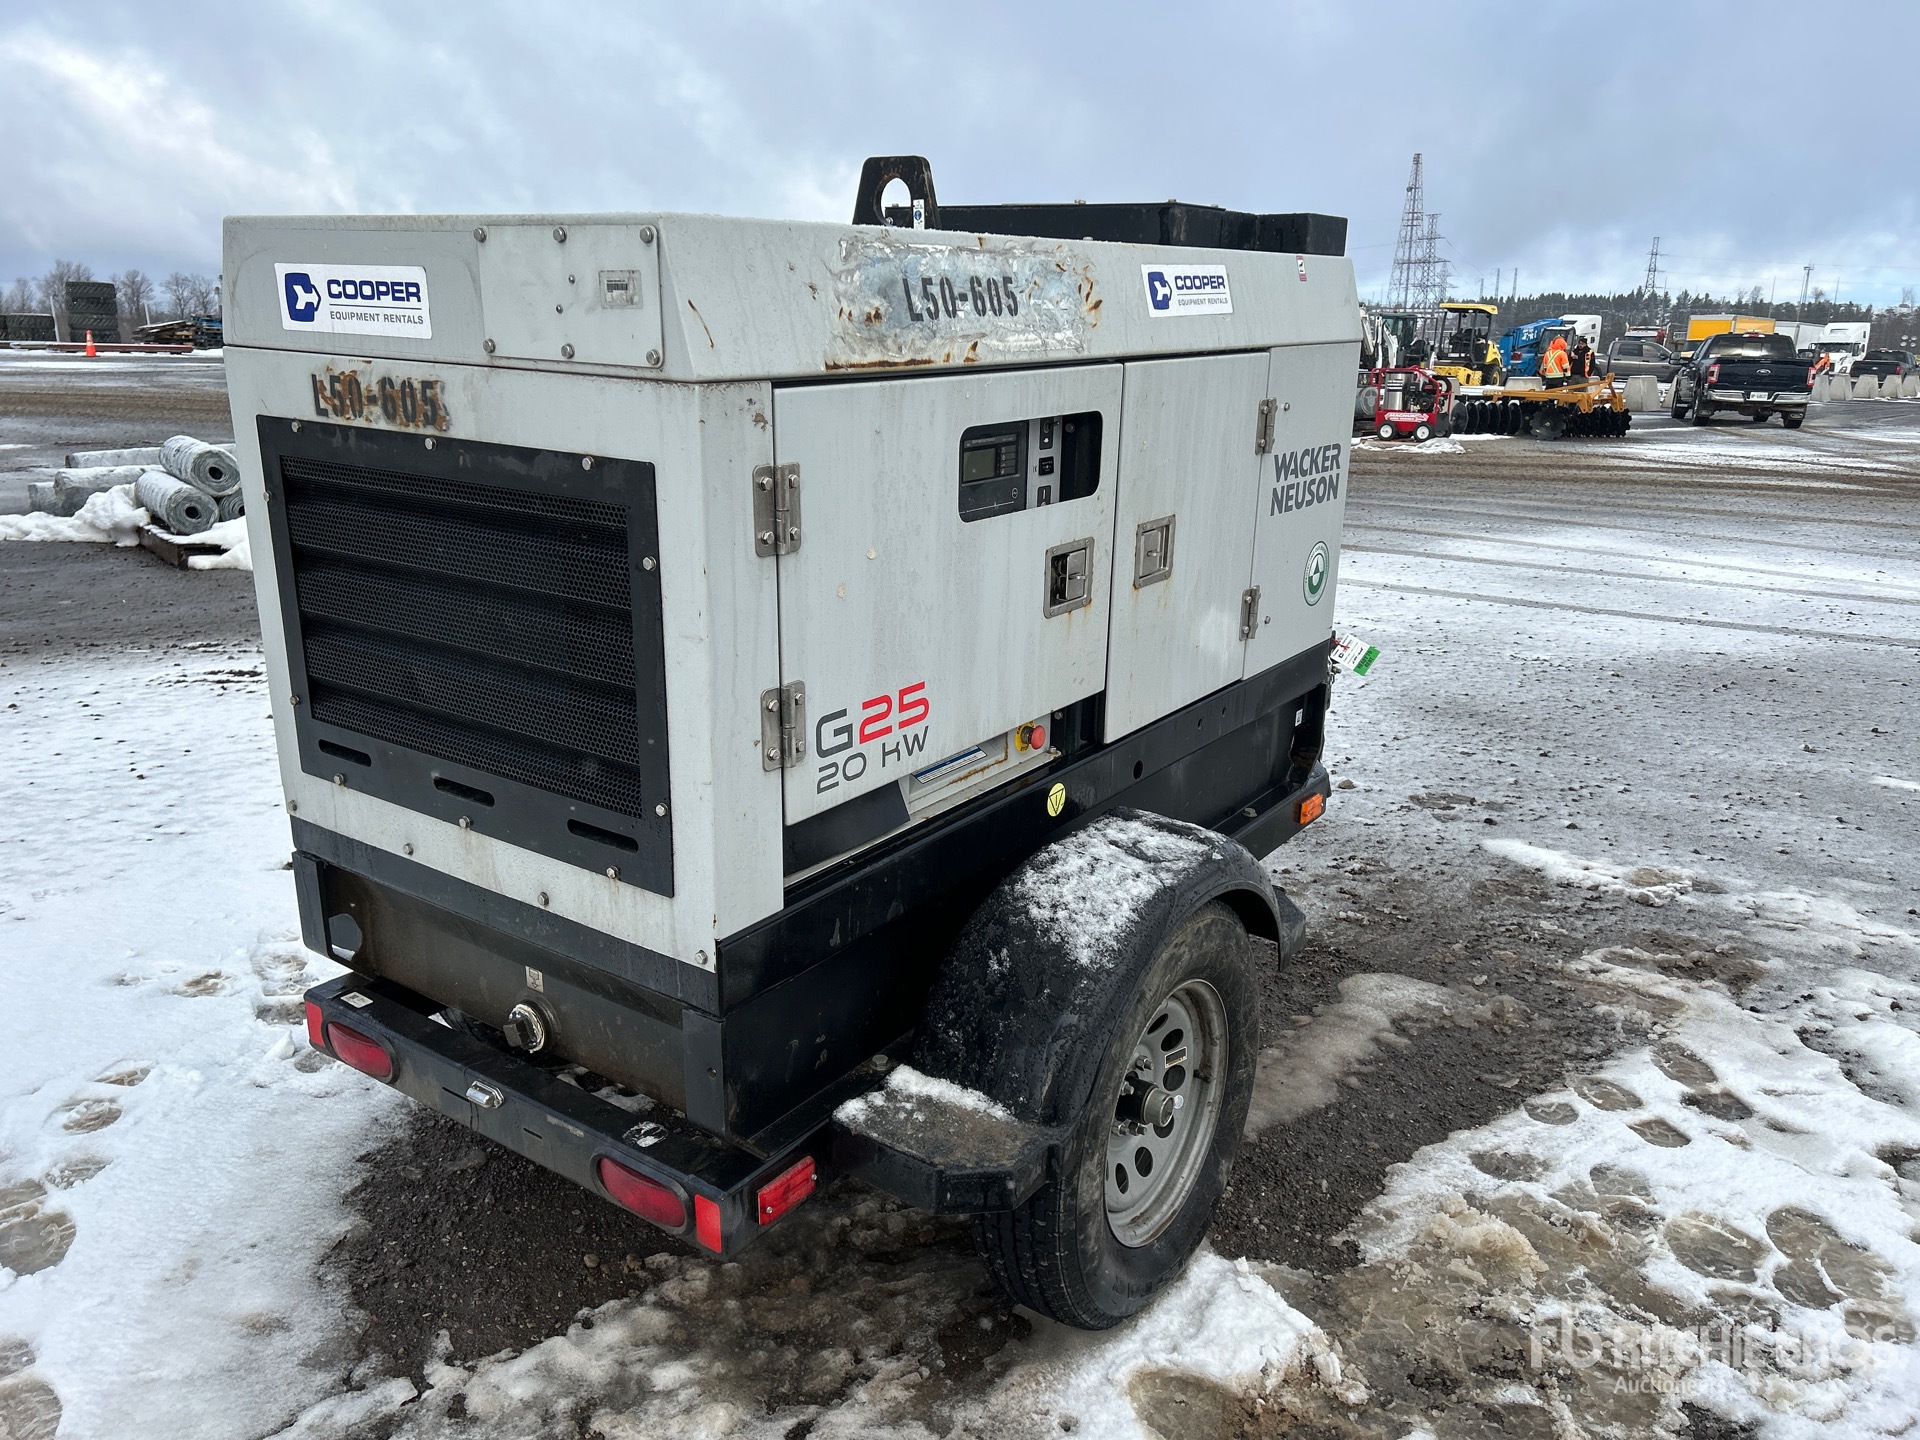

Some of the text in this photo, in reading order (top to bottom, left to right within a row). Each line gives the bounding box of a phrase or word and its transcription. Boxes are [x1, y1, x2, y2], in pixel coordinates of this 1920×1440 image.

[326, 279, 422, 303] COOPER
[902, 275, 1019, 322] L50-605
[1174, 275, 1226, 290] COOPER
[1178, 297, 1228, 306] EQUIPMENT RENTALS
[329, 310, 424, 325] EQUIPMENT RENTALS
[311, 373, 438, 426] L50-605
[1273, 443, 1341, 483] WACKER
[1270, 473, 1340, 516] NEUSON
[815, 680, 929, 758] G25
[816, 752, 867, 795] 20
